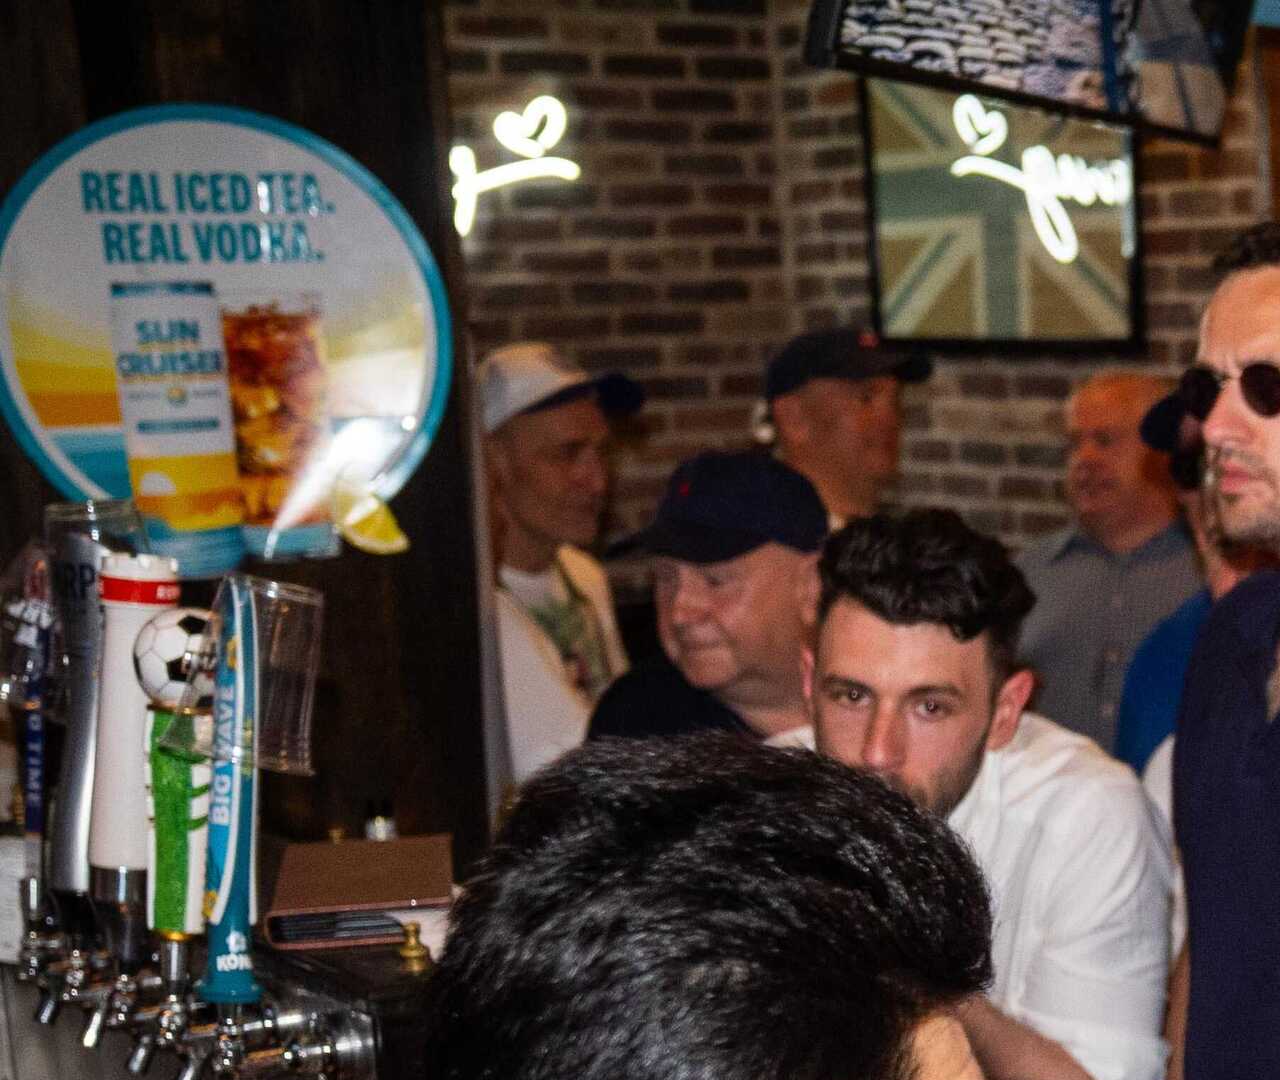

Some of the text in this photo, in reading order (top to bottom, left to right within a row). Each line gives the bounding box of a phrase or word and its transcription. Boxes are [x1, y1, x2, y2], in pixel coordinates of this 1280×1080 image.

[81, 171, 336, 215] REAL ICED TEA.
[104, 222, 324, 264] REAL VODKA.
[210, 766, 232, 826] BIG
